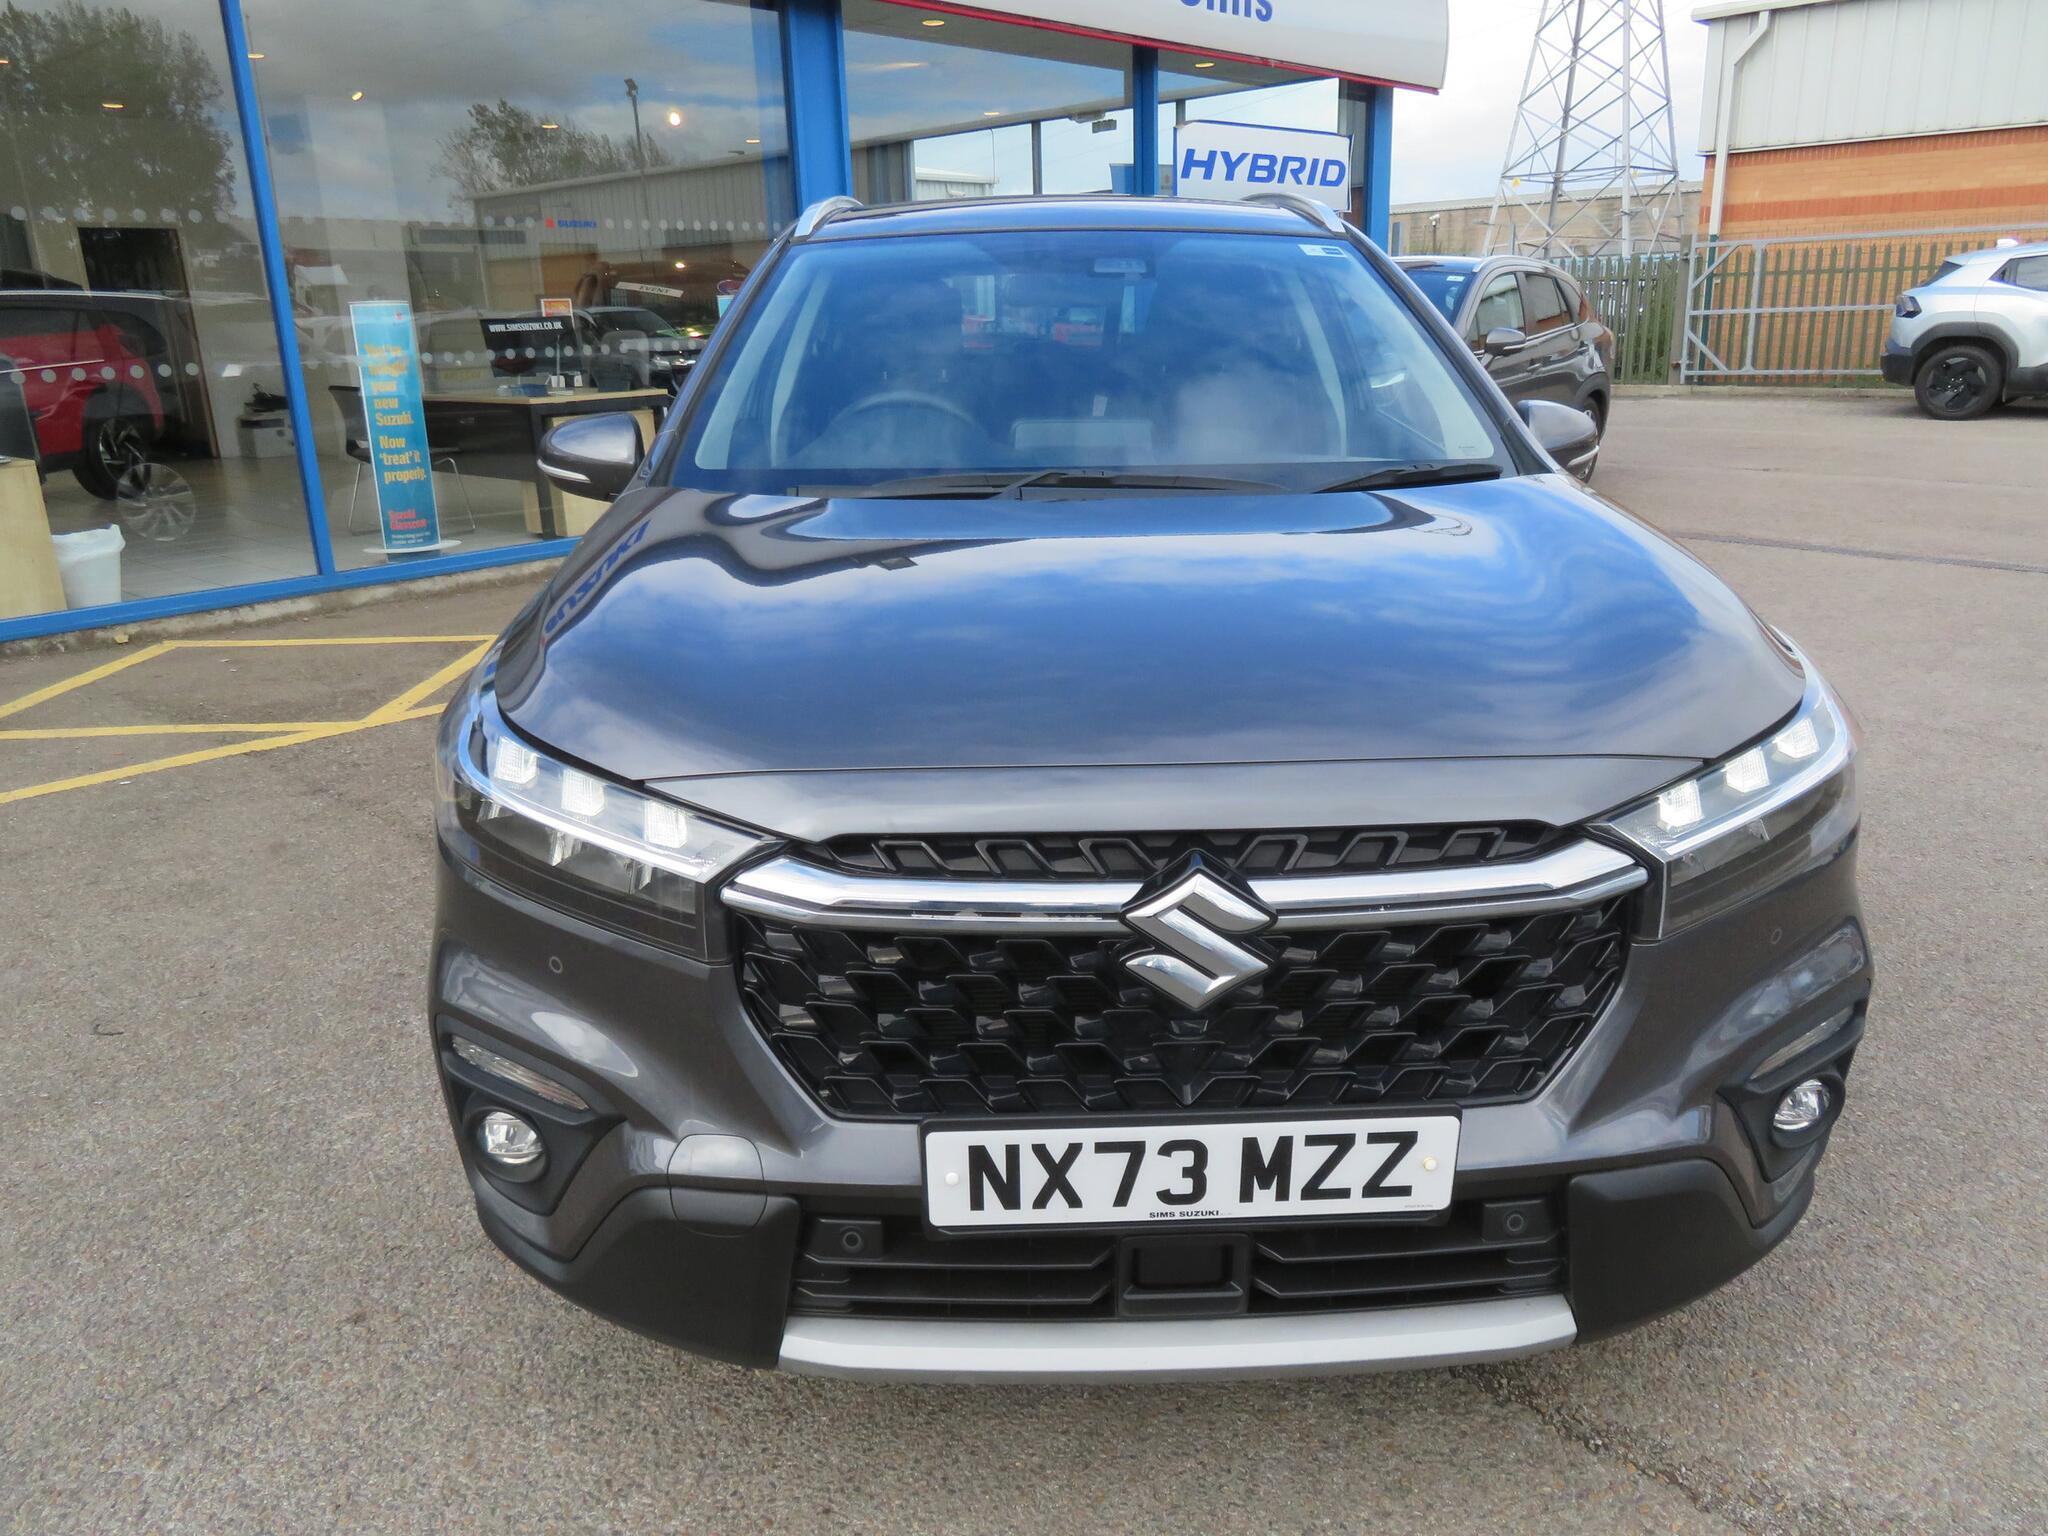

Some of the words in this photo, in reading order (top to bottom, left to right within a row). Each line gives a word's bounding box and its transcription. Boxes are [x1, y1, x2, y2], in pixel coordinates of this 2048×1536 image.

[1181, 148, 1346, 187] HYBRID
[380, 435, 406, 449] Now
[967, 1139, 1208, 1212] NX73
[1239, 1130, 1419, 1204] MZZ
[1149, 1211, 1176, 1219] SIMS
[1179, 1209, 1220, 1218] SUZUKI
